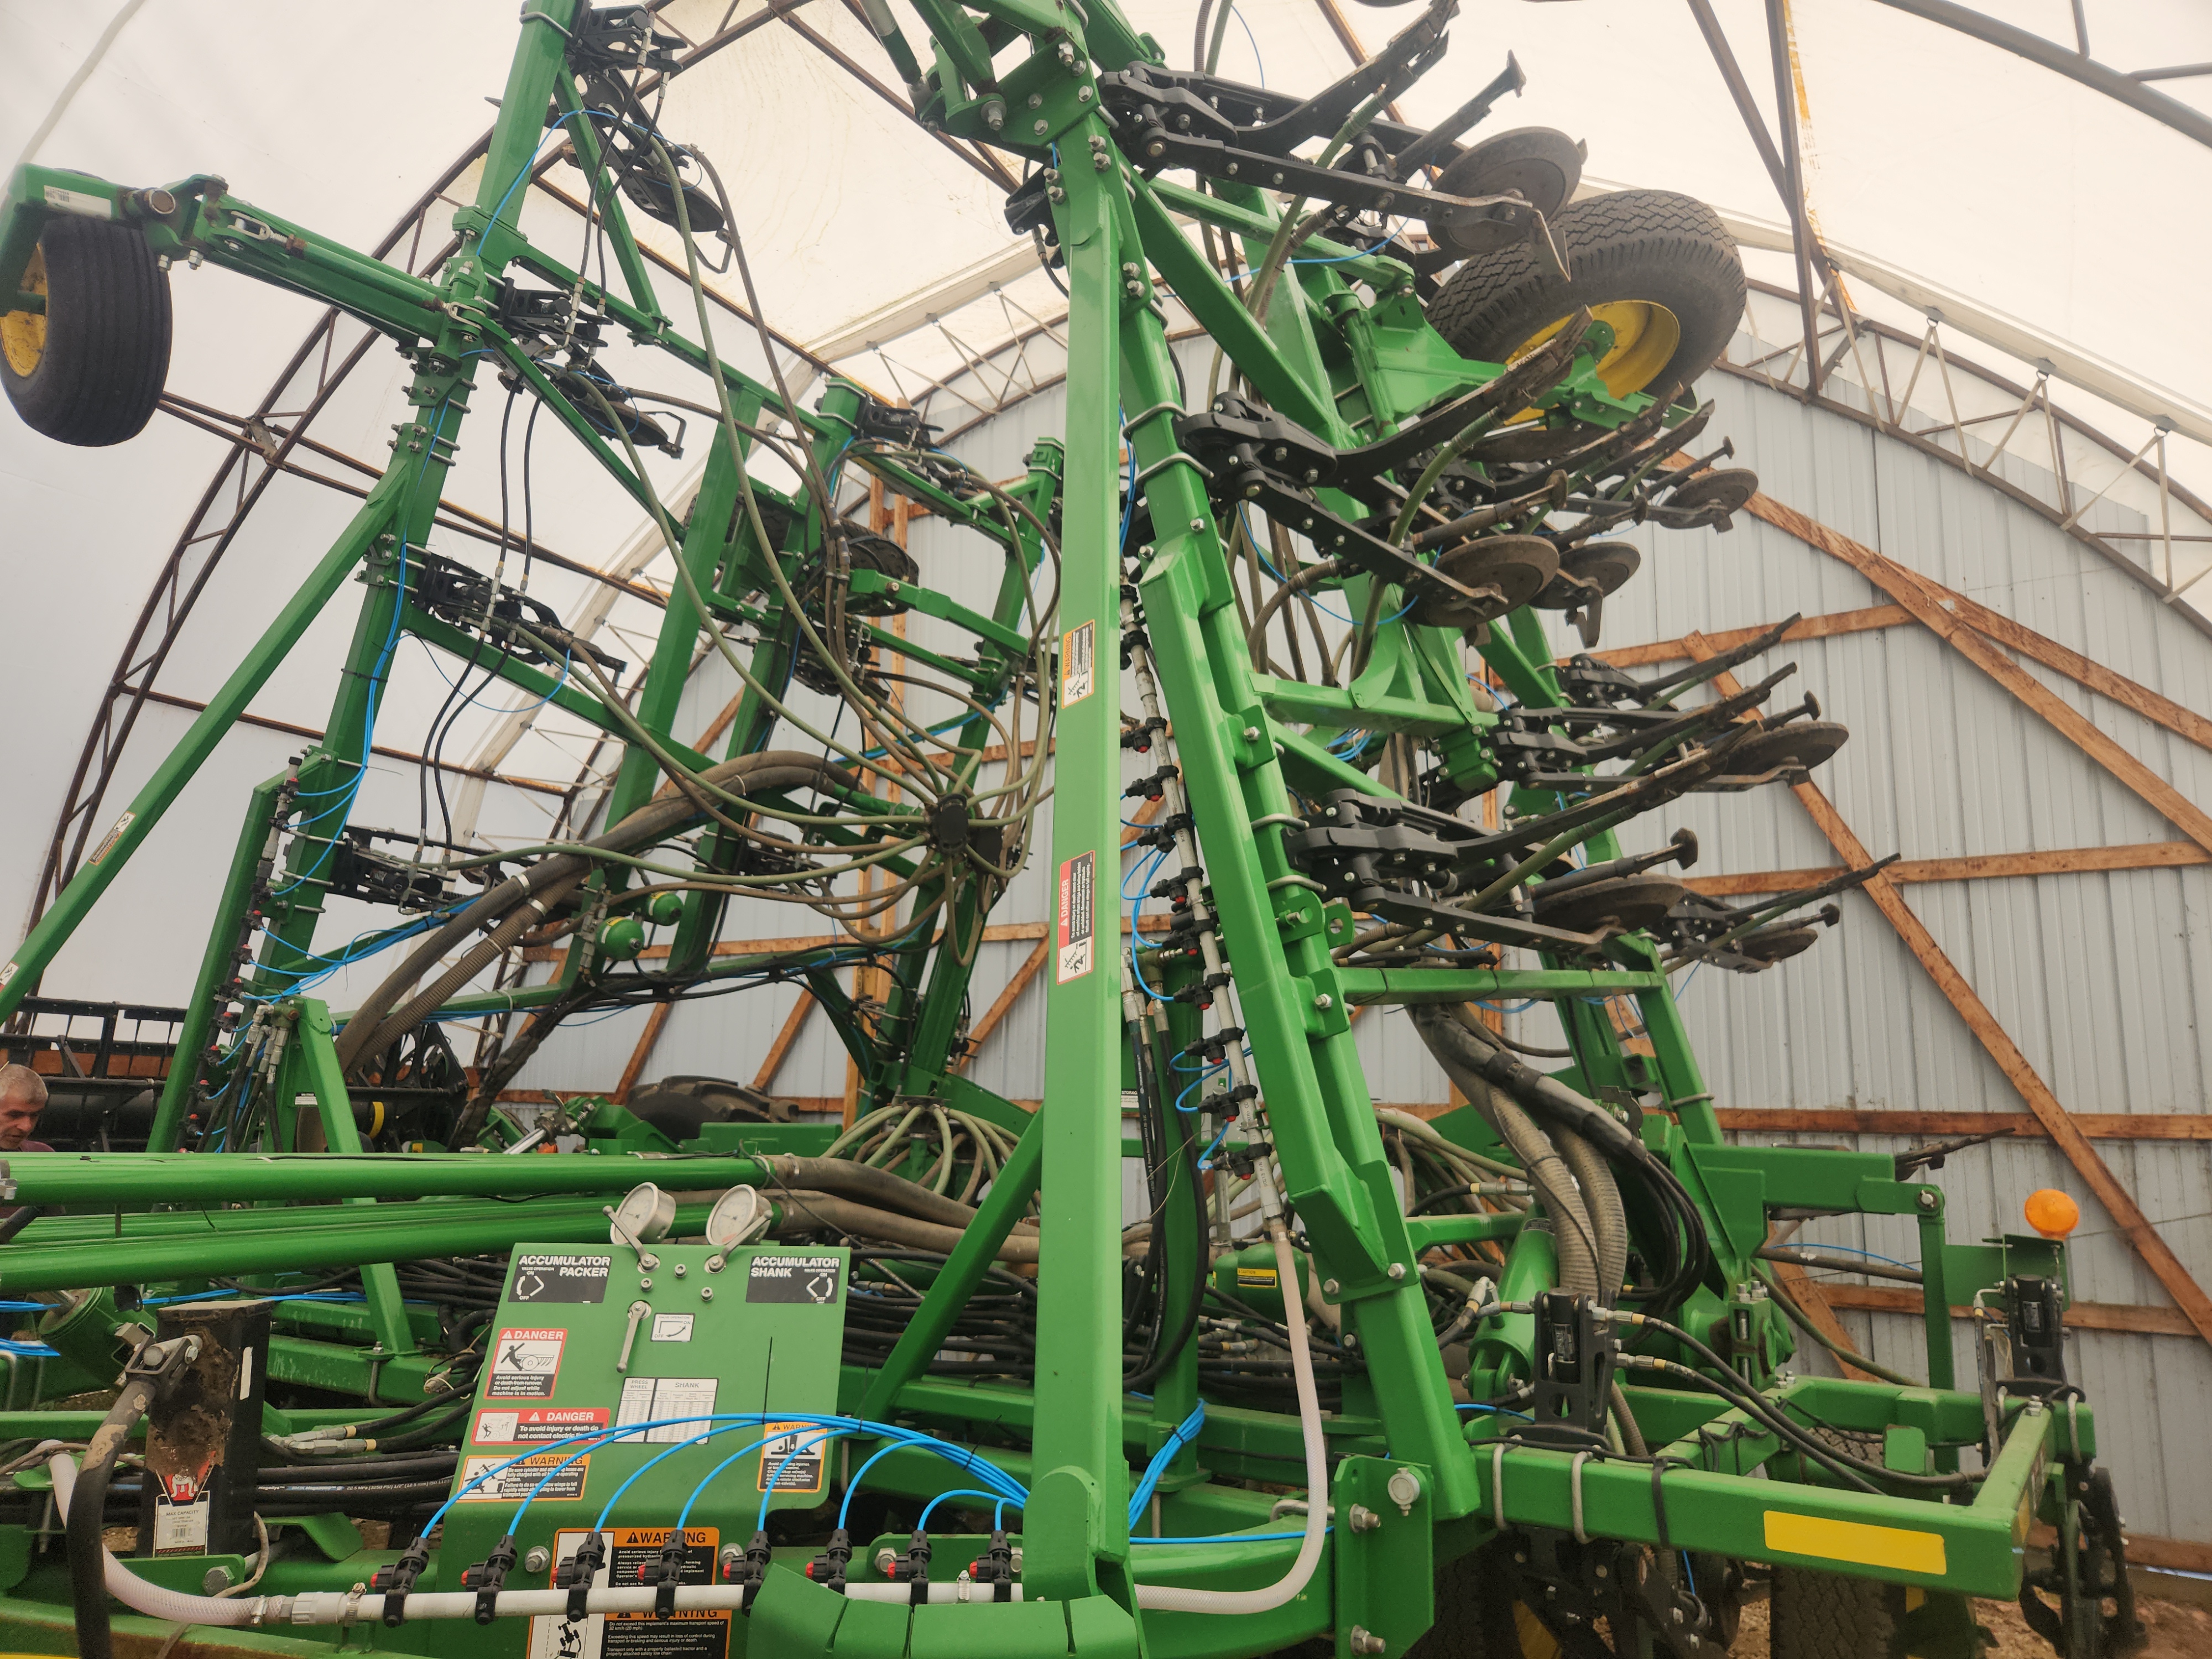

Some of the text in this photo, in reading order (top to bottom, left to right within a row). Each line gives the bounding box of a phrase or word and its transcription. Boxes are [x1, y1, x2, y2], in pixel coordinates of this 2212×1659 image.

[519, 1255, 611, 1266] ACCUMULATOR
[752, 1256, 840, 1267] ACCUMULATOR
[559, 1267, 608, 1277] PACKER
[750, 1267, 792, 1277] SHANK
[514, 1331, 564, 1339] DANGER
[546, 1412, 594, 1421] DANGER
[640, 1532, 706, 1543] WARNG
